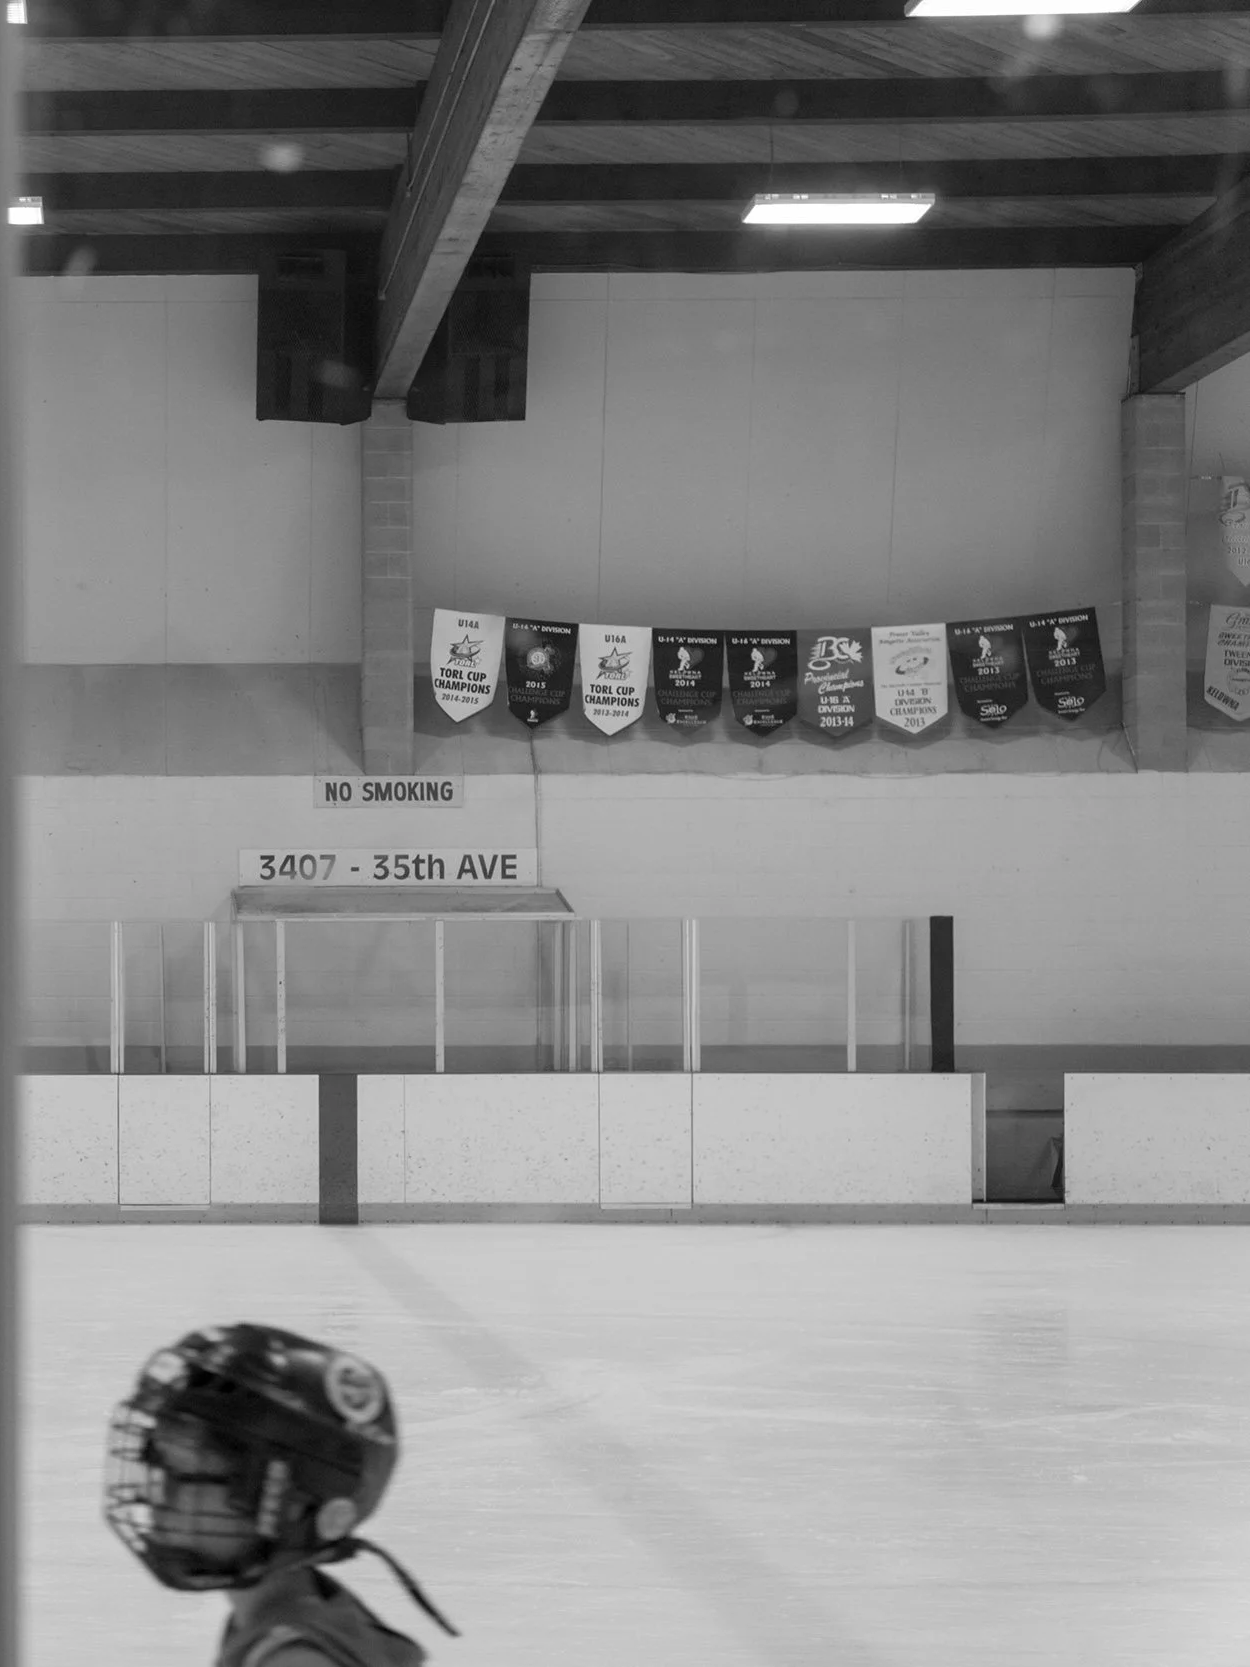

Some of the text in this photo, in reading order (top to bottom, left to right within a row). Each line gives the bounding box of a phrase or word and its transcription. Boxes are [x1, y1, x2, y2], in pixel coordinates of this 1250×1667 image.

[1058, 614, 1089, 625] DIVISION
[541, 625, 572, 635] DIVISION
[983, 623, 1014, 633] DIVISION
[604, 634, 627, 644] U16A
[687, 637, 717, 645] DIVISION
[1053, 657, 1077, 667] 2013
[1223, 659, 1250, 667] DIVISI
[440, 667, 487, 682] TORL CUP
[977, 666, 1000, 675] 2013
[434, 678, 491, 695] CHAMPIONS
[525, 681, 547, 689] 2015
[817, 680, 864, 695] Champions
[590, 684, 635, 697] TORL CUP
[441, 693, 479, 704] 2014-2015
[584, 694, 640, 708] CHAMPIONS
[894, 697, 933, 706] DIVISION
[817, 704, 856, 714] DIVISION
[889, 706, 938, 716] CHAMPIONS
[819, 716, 854, 728] 2013-14
[903, 717, 926, 728] 2013
[324, 781, 453, 802] NO SMOKING
[259, 853, 337, 882] 3407
[373, 853, 446, 882] 35th
[456, 854, 519, 881] AVE
